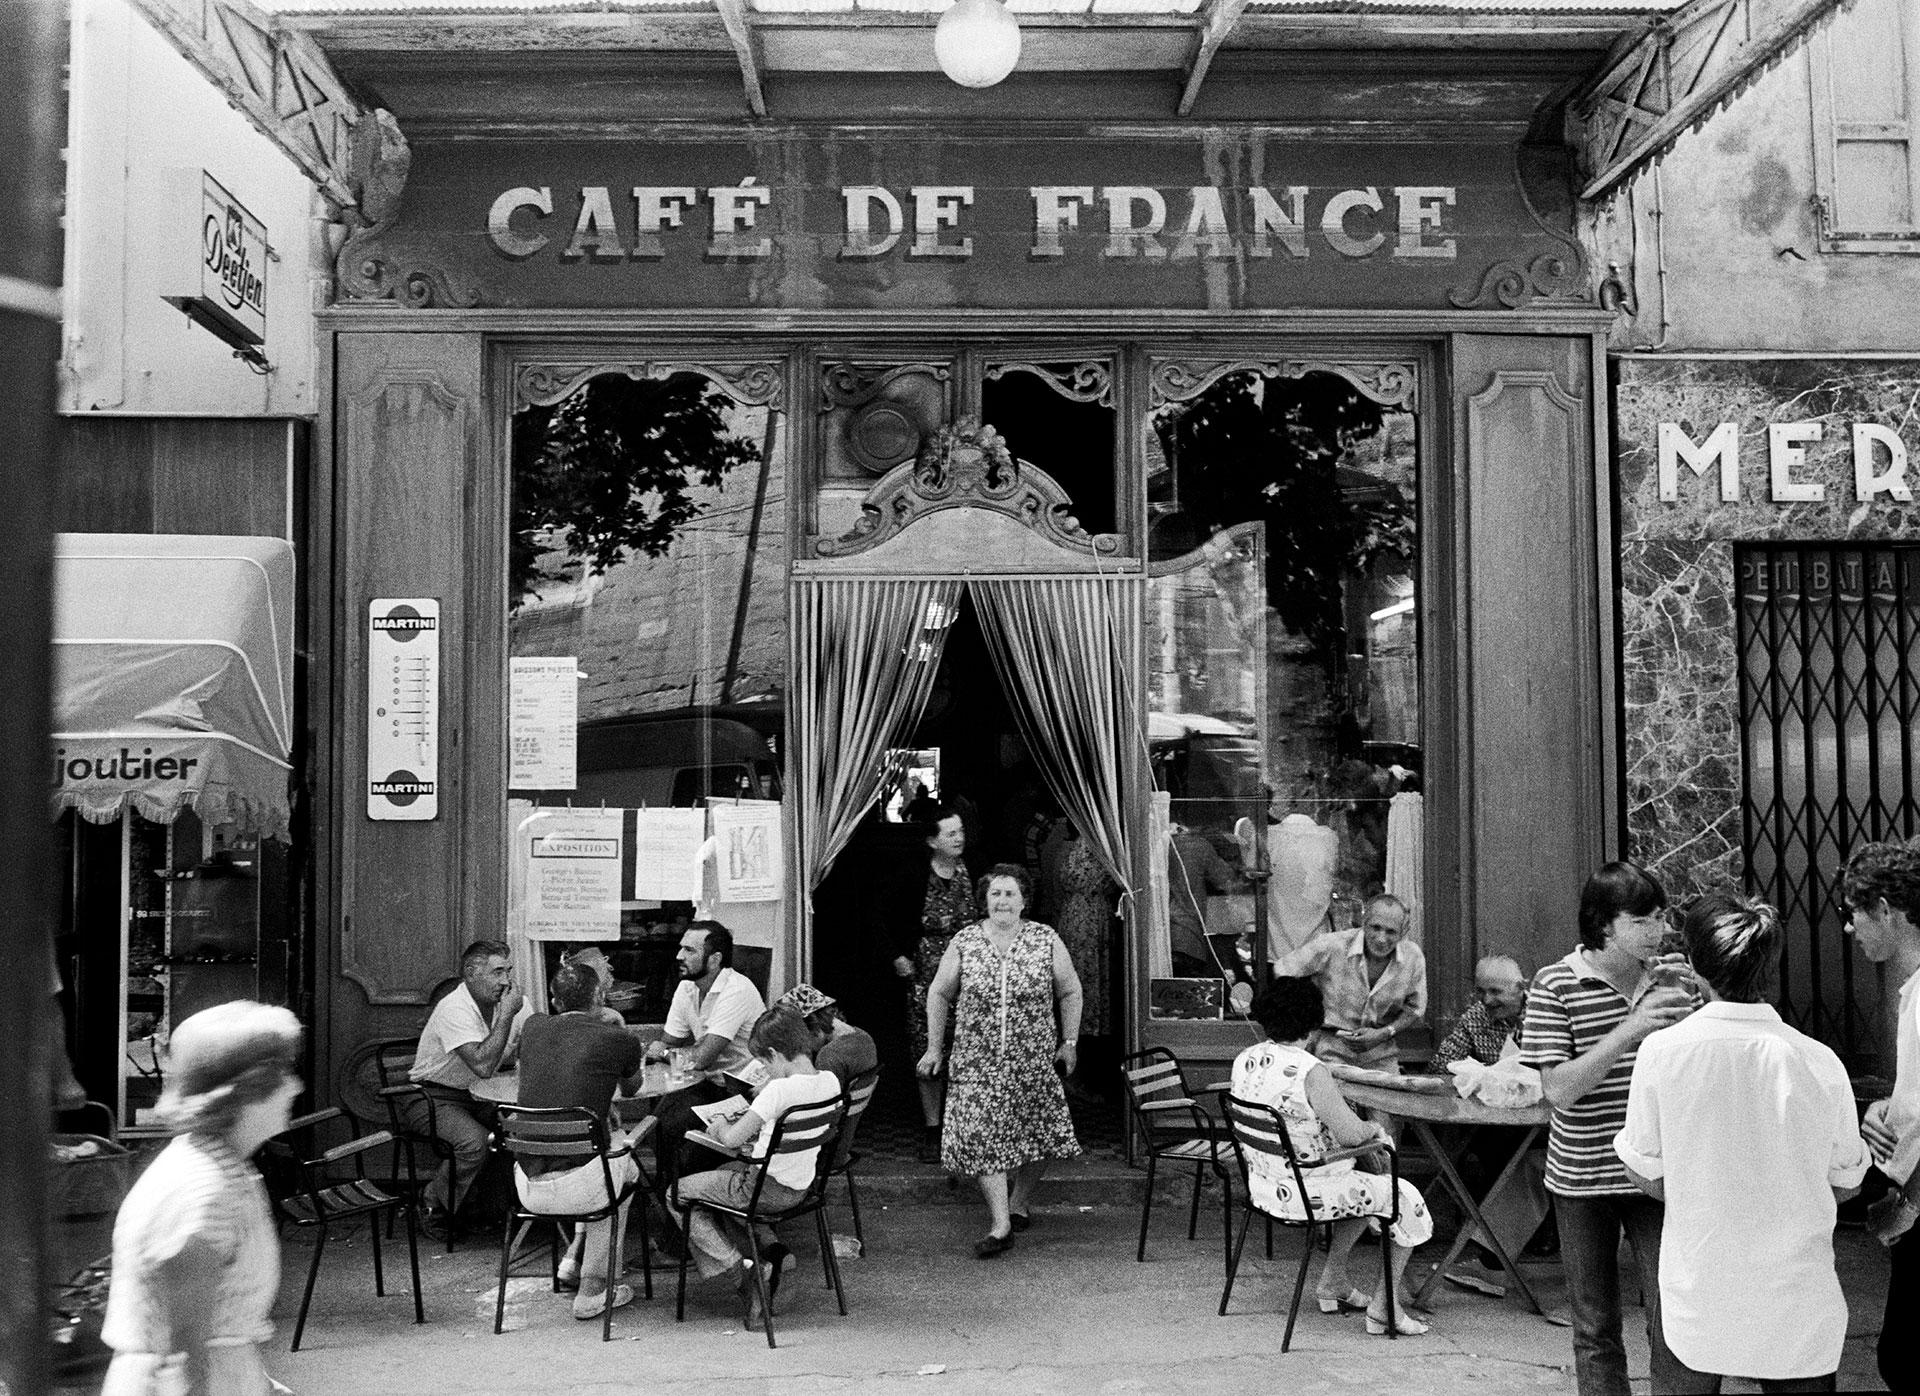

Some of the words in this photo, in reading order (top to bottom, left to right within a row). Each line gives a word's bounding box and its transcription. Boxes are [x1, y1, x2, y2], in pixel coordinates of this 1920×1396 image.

[488, 176, 771, 257] CAFÉ
[840, 185, 974, 257] DE
[1030, 185, 1458, 258] FRANCE
[204, 214, 263, 310] Deetjen
[1657, 422, 1915, 502] MER
[374, 618, 435, 629] MARTINI
[372, 783, 433, 793] MARTINI
